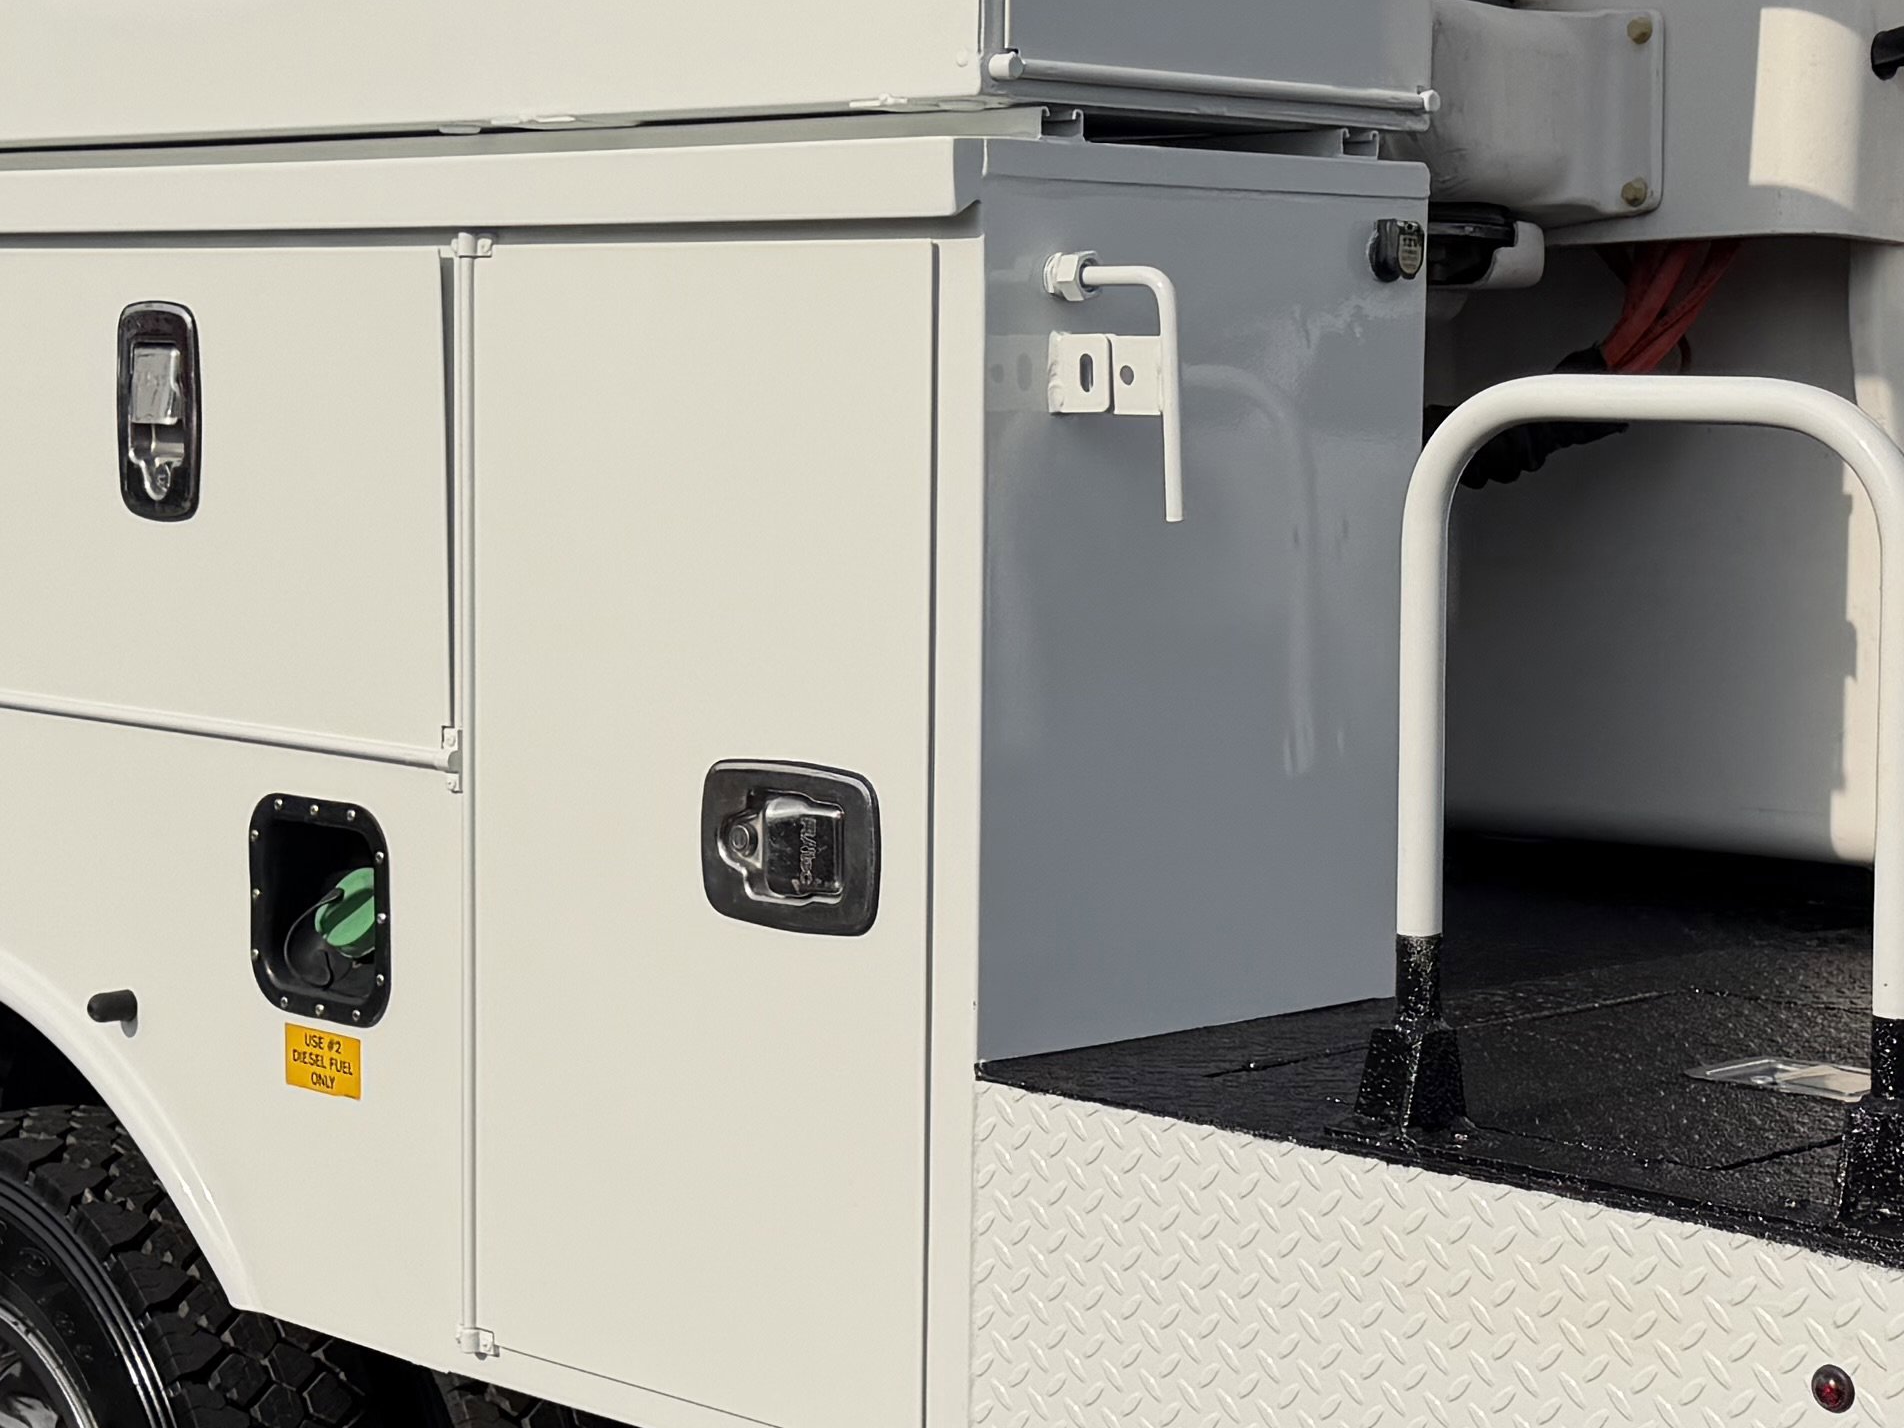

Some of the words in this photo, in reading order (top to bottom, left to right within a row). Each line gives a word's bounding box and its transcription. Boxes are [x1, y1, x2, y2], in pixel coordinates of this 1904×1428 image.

[304, 1032, 324, 1050] USE
[292, 1048, 326, 1069] DIESEL
[329, 1057, 353, 1075] FUEL
[310, 1071, 335, 1089] ONLY
